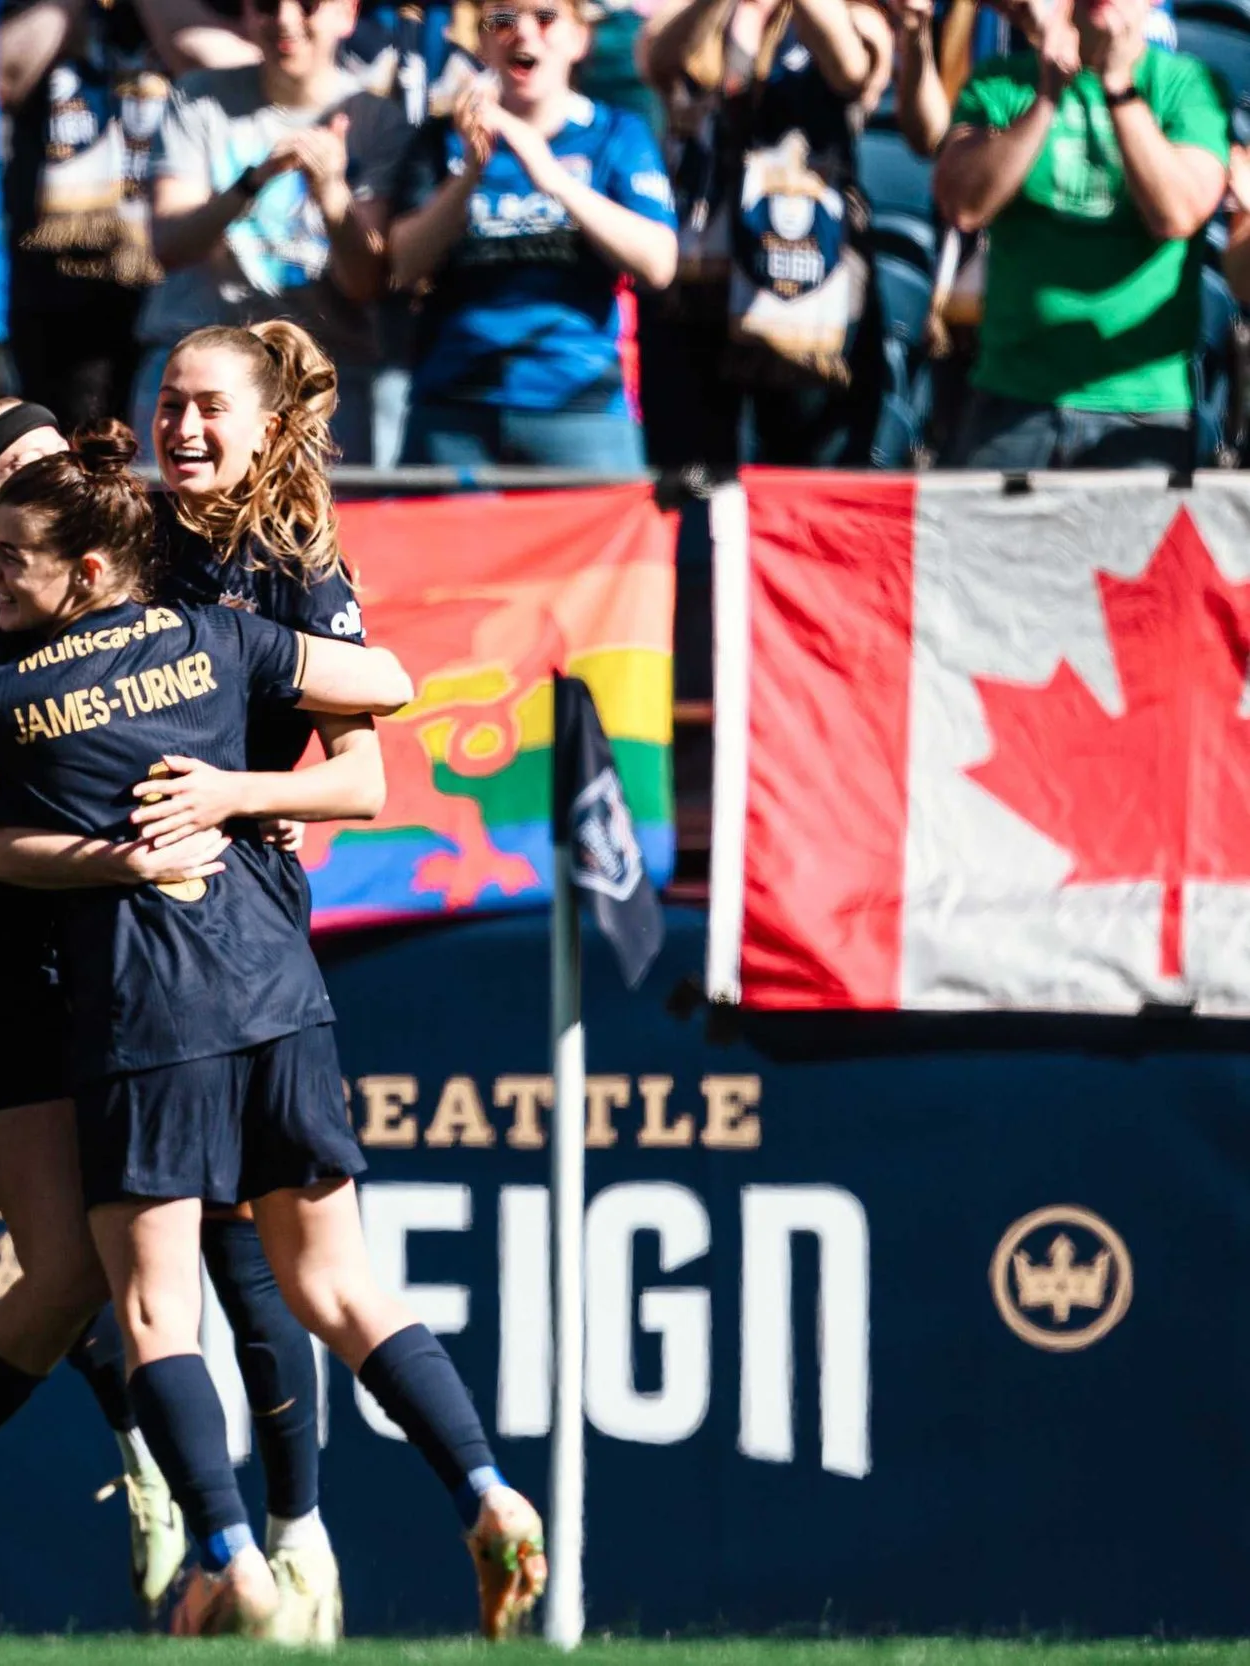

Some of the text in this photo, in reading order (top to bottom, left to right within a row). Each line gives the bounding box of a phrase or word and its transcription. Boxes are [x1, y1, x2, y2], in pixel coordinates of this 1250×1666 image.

[14, 651, 218, 745] JAMES-TURNER
[341, 1073, 762, 1150] EATTLE
[200, 1180, 871, 1479] EIGN
